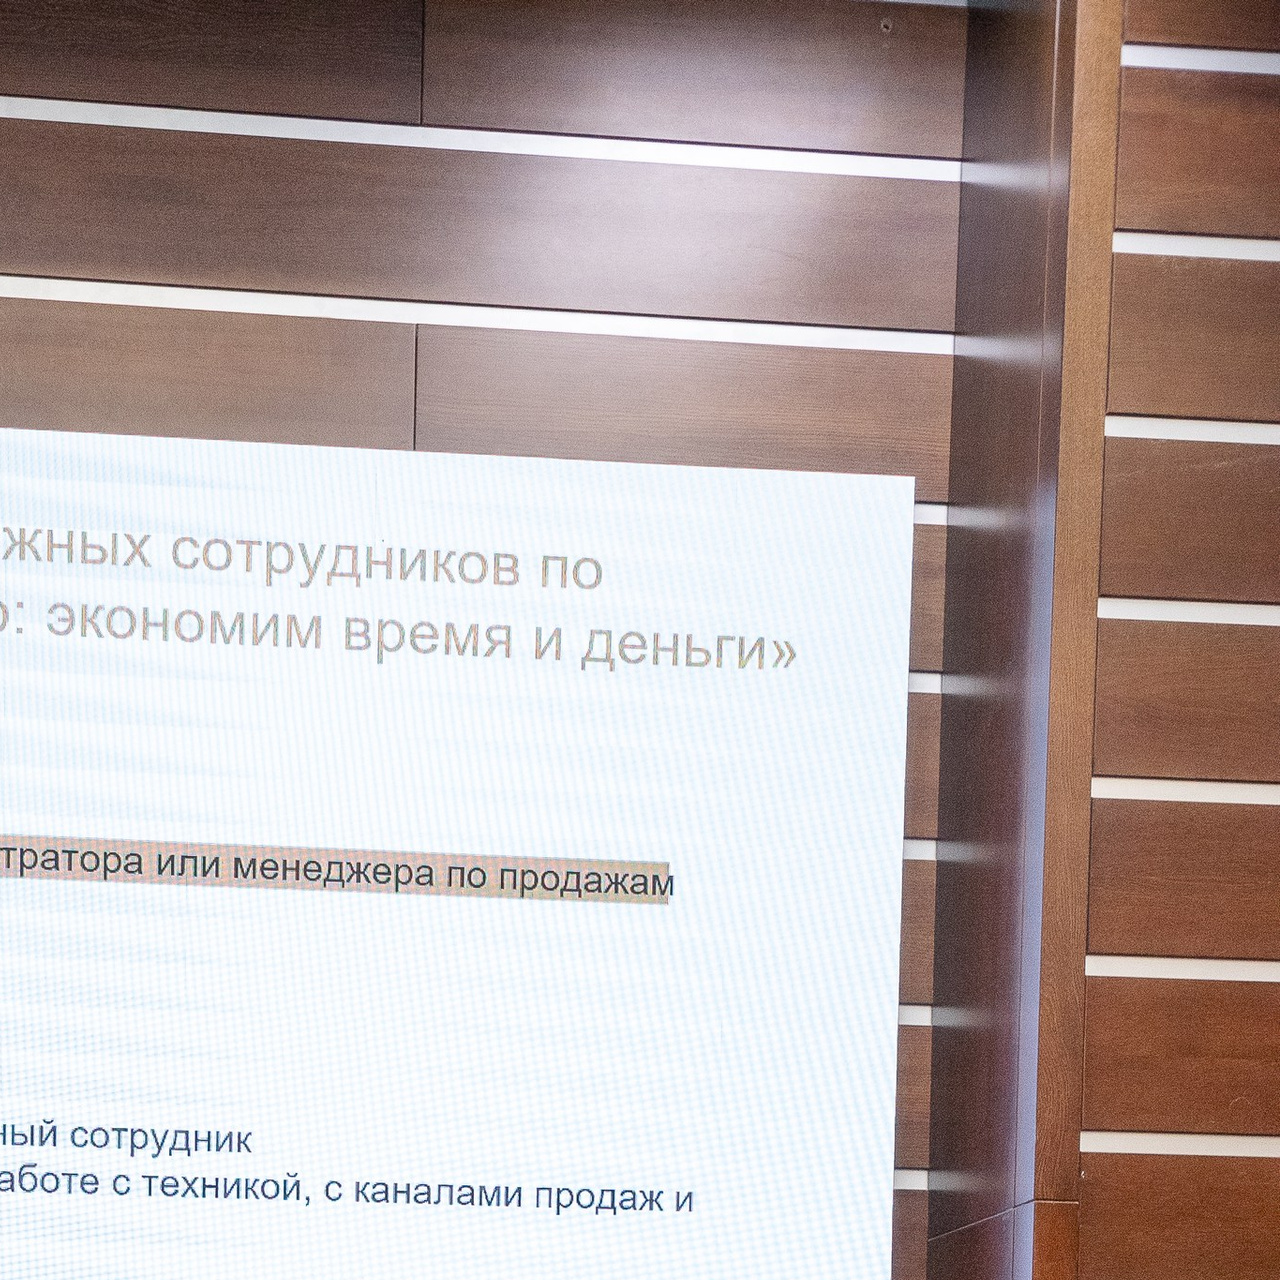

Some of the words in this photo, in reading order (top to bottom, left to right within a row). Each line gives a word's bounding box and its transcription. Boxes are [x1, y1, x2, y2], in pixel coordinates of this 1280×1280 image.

[171, 535, 520, 589] сотрудников
[541, 554, 604, 590] по
[46, 601, 323, 650] экономим
[344, 616, 512, 666] время
[533, 626, 563, 662] и
[580, 628, 797, 673] деньги»
[156, 853, 220, 878] или
[233, 856, 434, 893] менеджера
[446, 865, 487, 890] по
[499, 867, 674, 899] продажам
[69, 1125, 253, 1160] сотрудник
[111, 1173, 132, 1197] с
[141, 1172, 311, 1207] техникой,
[323, 1179, 343, 1203] с
[354, 1180, 523, 1208] каналами
[535, 1186, 665, 1216] продаж
[674, 1190, 694, 1213] и
